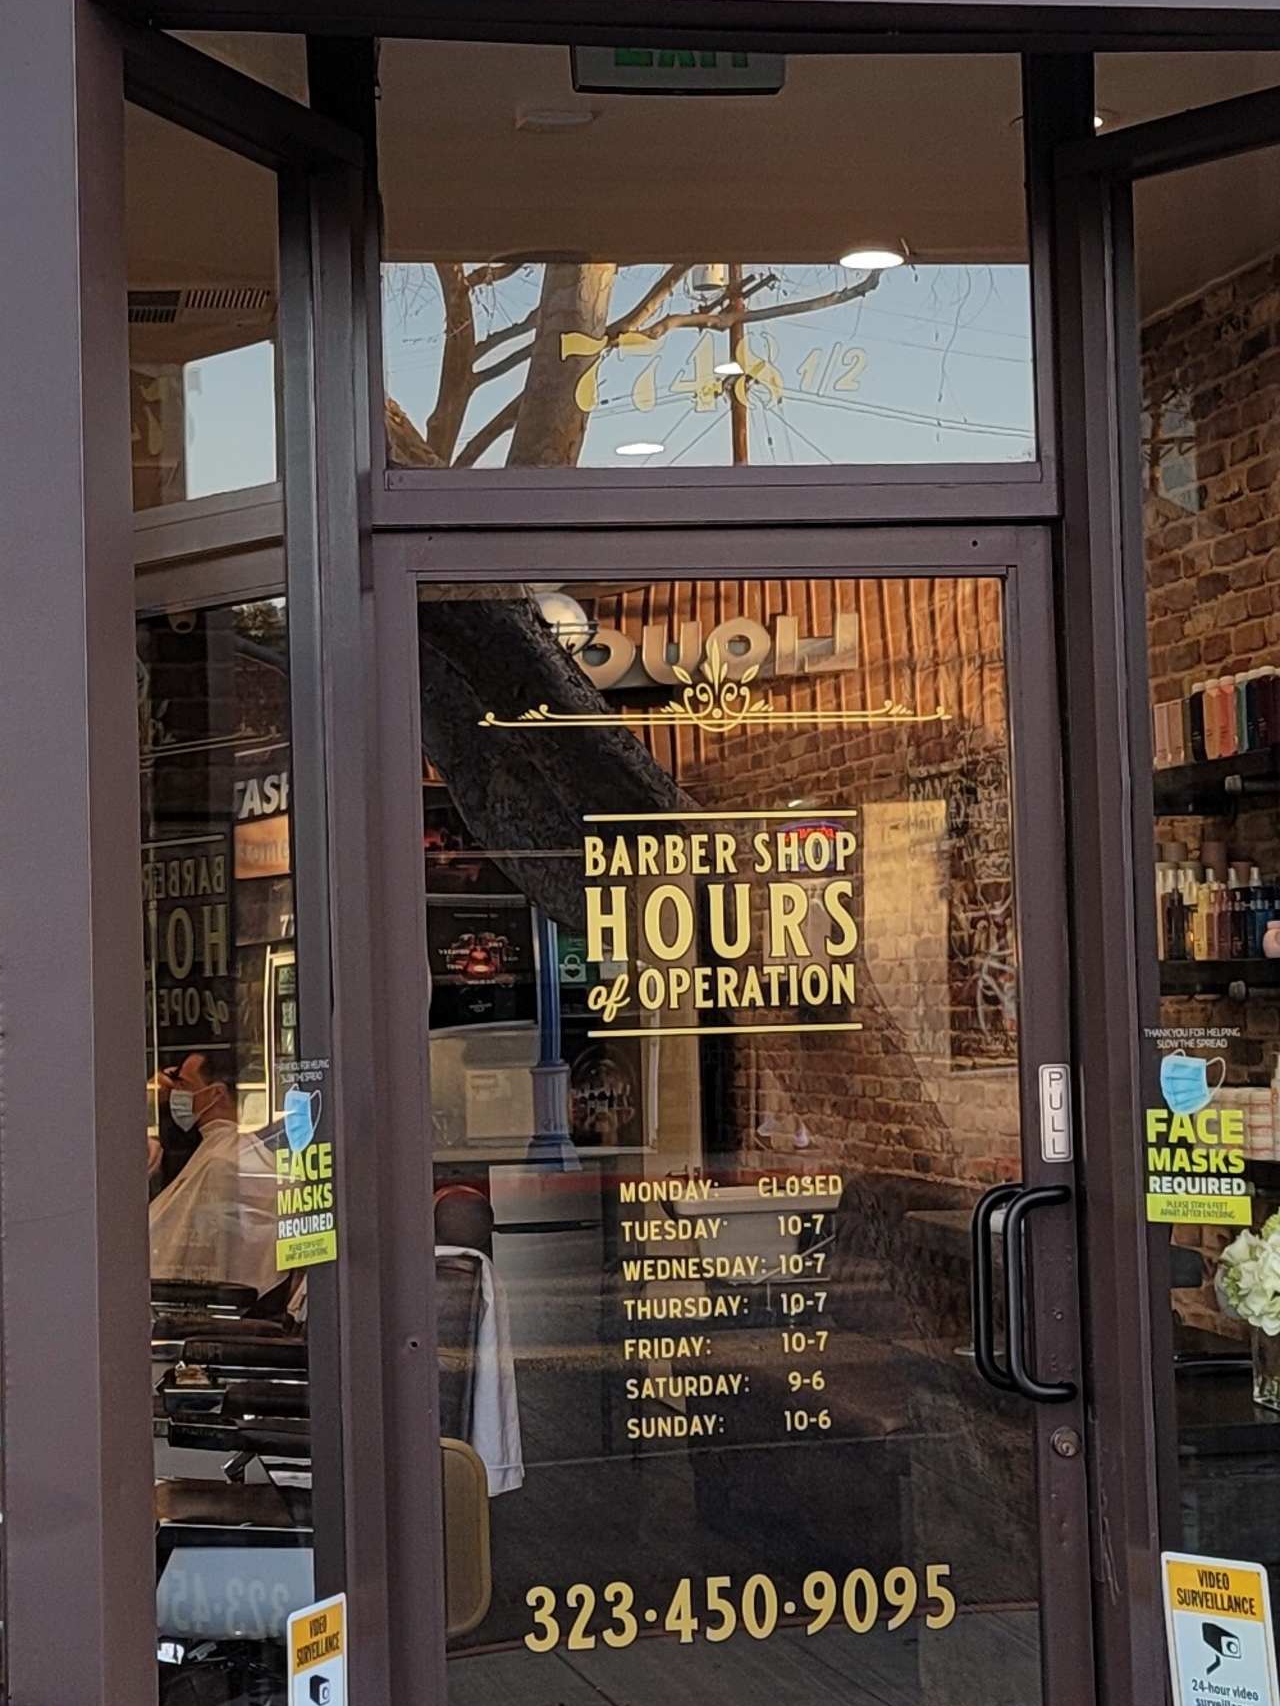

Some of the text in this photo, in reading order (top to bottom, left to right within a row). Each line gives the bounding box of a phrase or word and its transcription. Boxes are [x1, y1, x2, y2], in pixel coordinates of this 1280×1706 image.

[560, 330, 867, 414] 7748 1/2
[584, 832, 738, 877] BARBER
[753, 831, 858, 874] SHOP
[585, 880, 859, 962] HOURS
[587, 963, 856, 1023] of OPERATION
[1196, 1038, 1228, 1049] SPREAD
[1206, 1027, 1241, 1038] HELPING
[1048, 1070, 1066, 1155] PULL
[1146, 1108, 1244, 1145] FACE
[275, 1143, 333, 1185] FACE
[1147, 1147, 1246, 1174] MASKS
[277, 1182, 334, 1216] MASKS
[620, 1174, 843, 1204] MONDAY: CLOSED
[1148, 1176, 1247, 1196] REQUIRED
[277, 1212, 334, 1239] REQUIRED
[778, 1213, 825, 1237] 10-7
[623, 1252, 827, 1282] WEDNESDAY: 10-7
[624, 1291, 828, 1321] THURSDAY: 10-7
[624, 1330, 829, 1361] FRIDAY: 10-7
[625, 1370, 826, 1400] SATURDAY: 9-6
[627, 1409, 833, 1440] SUNDAY: 10-6
[1196, 1568, 1231, 1592] VIDEO
[1176, 1587, 1257, 1616] SURVEILLANCE
[309, 1612, 328, 1638] VIDEO
[296, 1631, 341, 1668] SURVEILLANCE
[1191, 1678, 1260, 1702] 24-hour video
